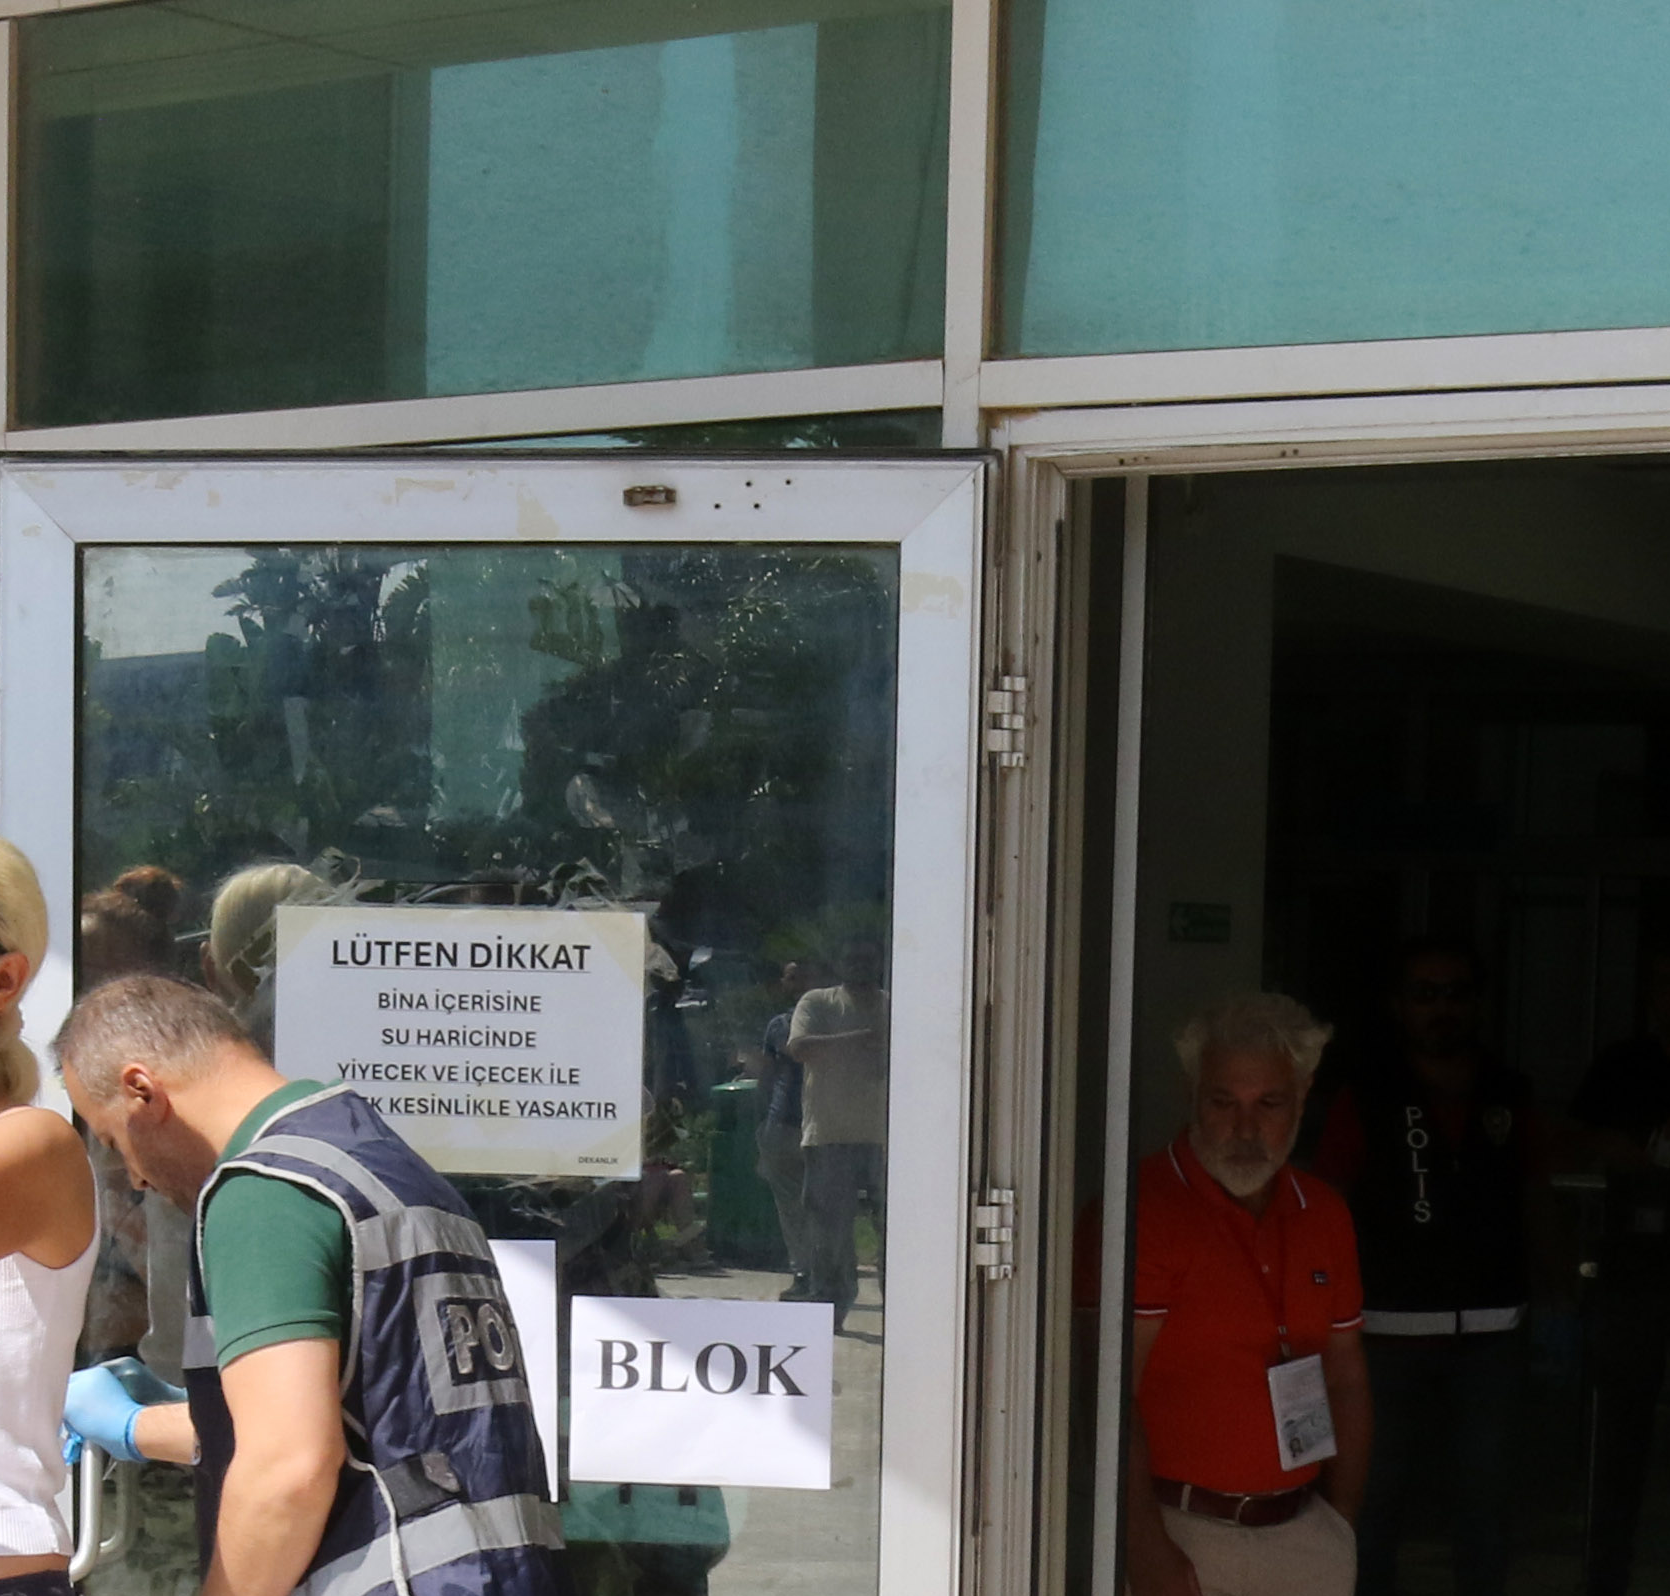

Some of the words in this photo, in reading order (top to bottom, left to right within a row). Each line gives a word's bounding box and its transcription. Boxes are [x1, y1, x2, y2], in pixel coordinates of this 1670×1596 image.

[332, 932, 458, 968] LÜTFEN
[470, 935, 592, 970] DİKKAT
[378, 987, 429, 1010] BİNA
[434, 988, 542, 1014] İÇERİSİNE
[381, 1028, 410, 1045] SU
[416, 1025, 537, 1048] HARİCİNDE
[337, 1058, 428, 1081] YİYECEK
[432, 1065, 459, 1081] VE
[465, 1060, 543, 1087] İÇECEK
[549, 1062, 580, 1085] İLE
[390, 1093, 510, 1117] KESİNLİKLE
[516, 1100, 618, 1119] YASAKTIR
[446, 1303, 525, 1374] PO
[596, 1339, 808, 1397] BLOK
